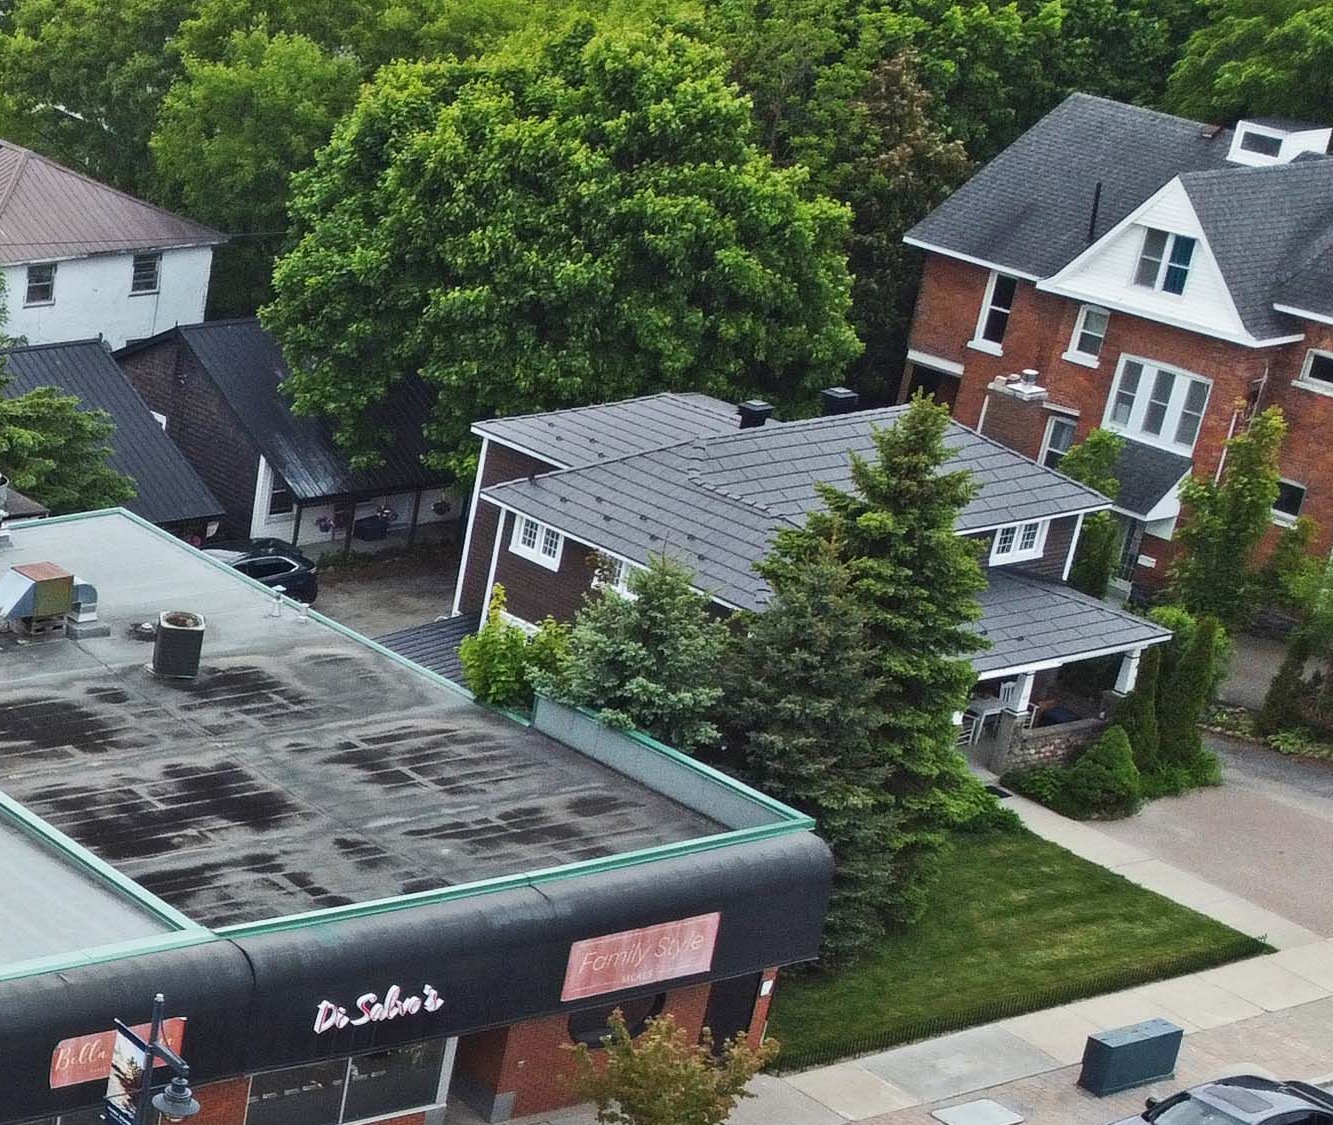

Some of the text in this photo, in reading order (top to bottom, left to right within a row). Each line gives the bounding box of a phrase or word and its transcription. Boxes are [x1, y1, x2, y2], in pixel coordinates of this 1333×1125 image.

[578, 934, 704, 974] Family Style
[313, 984, 445, 1034] Di Salvo's
[55, 1039, 108, 1071] Bella
